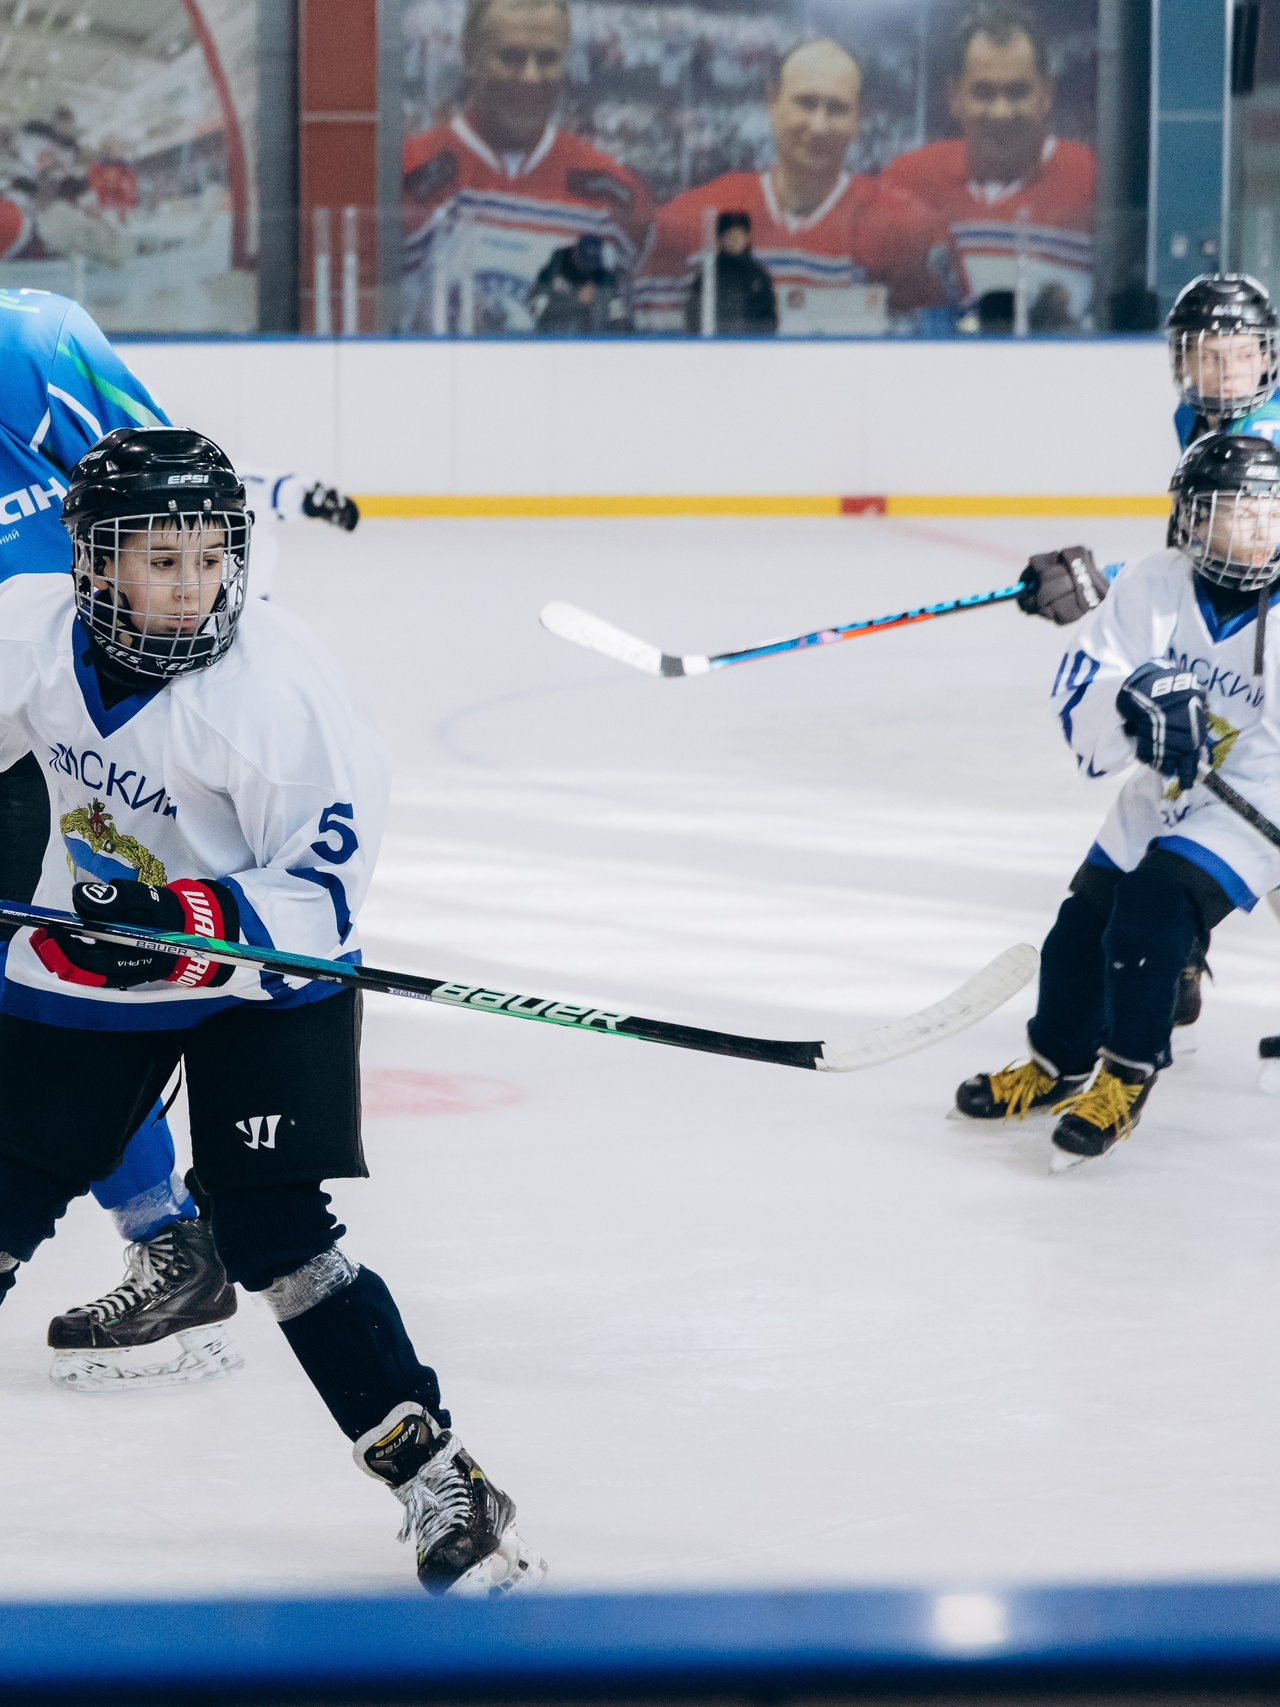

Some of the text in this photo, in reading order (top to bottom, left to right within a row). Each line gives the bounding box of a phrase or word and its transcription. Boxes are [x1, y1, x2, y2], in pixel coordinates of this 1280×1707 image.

[167, 474, 209, 485] EFSI
[309, 801, 360, 865] 5
[1, 908, 28, 918] BAUER
[136, 940, 188, 957] BAUER
[116, 957, 153, 968] ALPHA
[431, 981, 631, 1031] BAUER
[375, 1422, 416, 1459] BAUER
